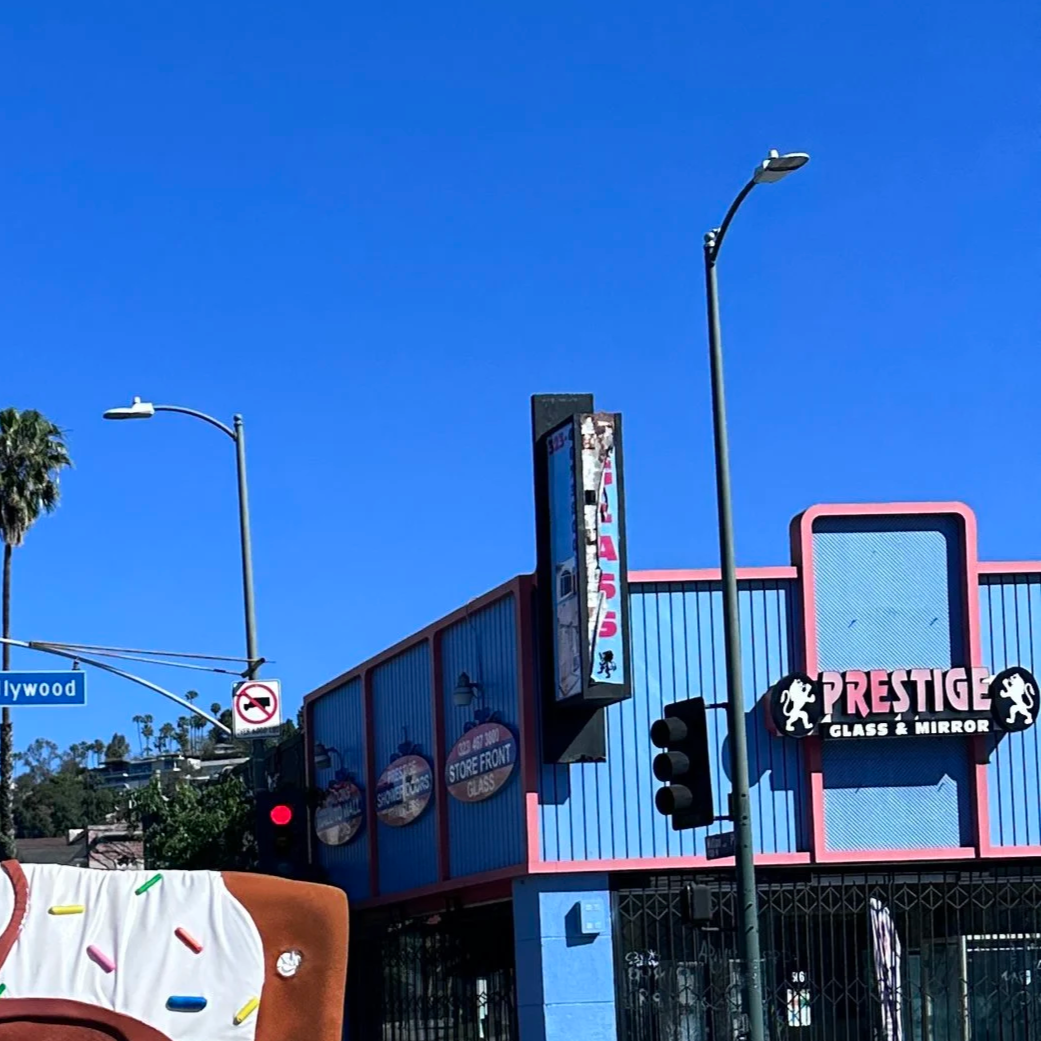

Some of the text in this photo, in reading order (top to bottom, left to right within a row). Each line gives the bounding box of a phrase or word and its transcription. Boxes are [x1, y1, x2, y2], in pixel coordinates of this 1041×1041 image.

[822, 667, 992, 718] PRESTIGE
[829, 719, 990, 738] GLASS & MIRROR
[449, 743, 511, 783] STORE FRONT
[467, 773, 495, 798] GLASS
